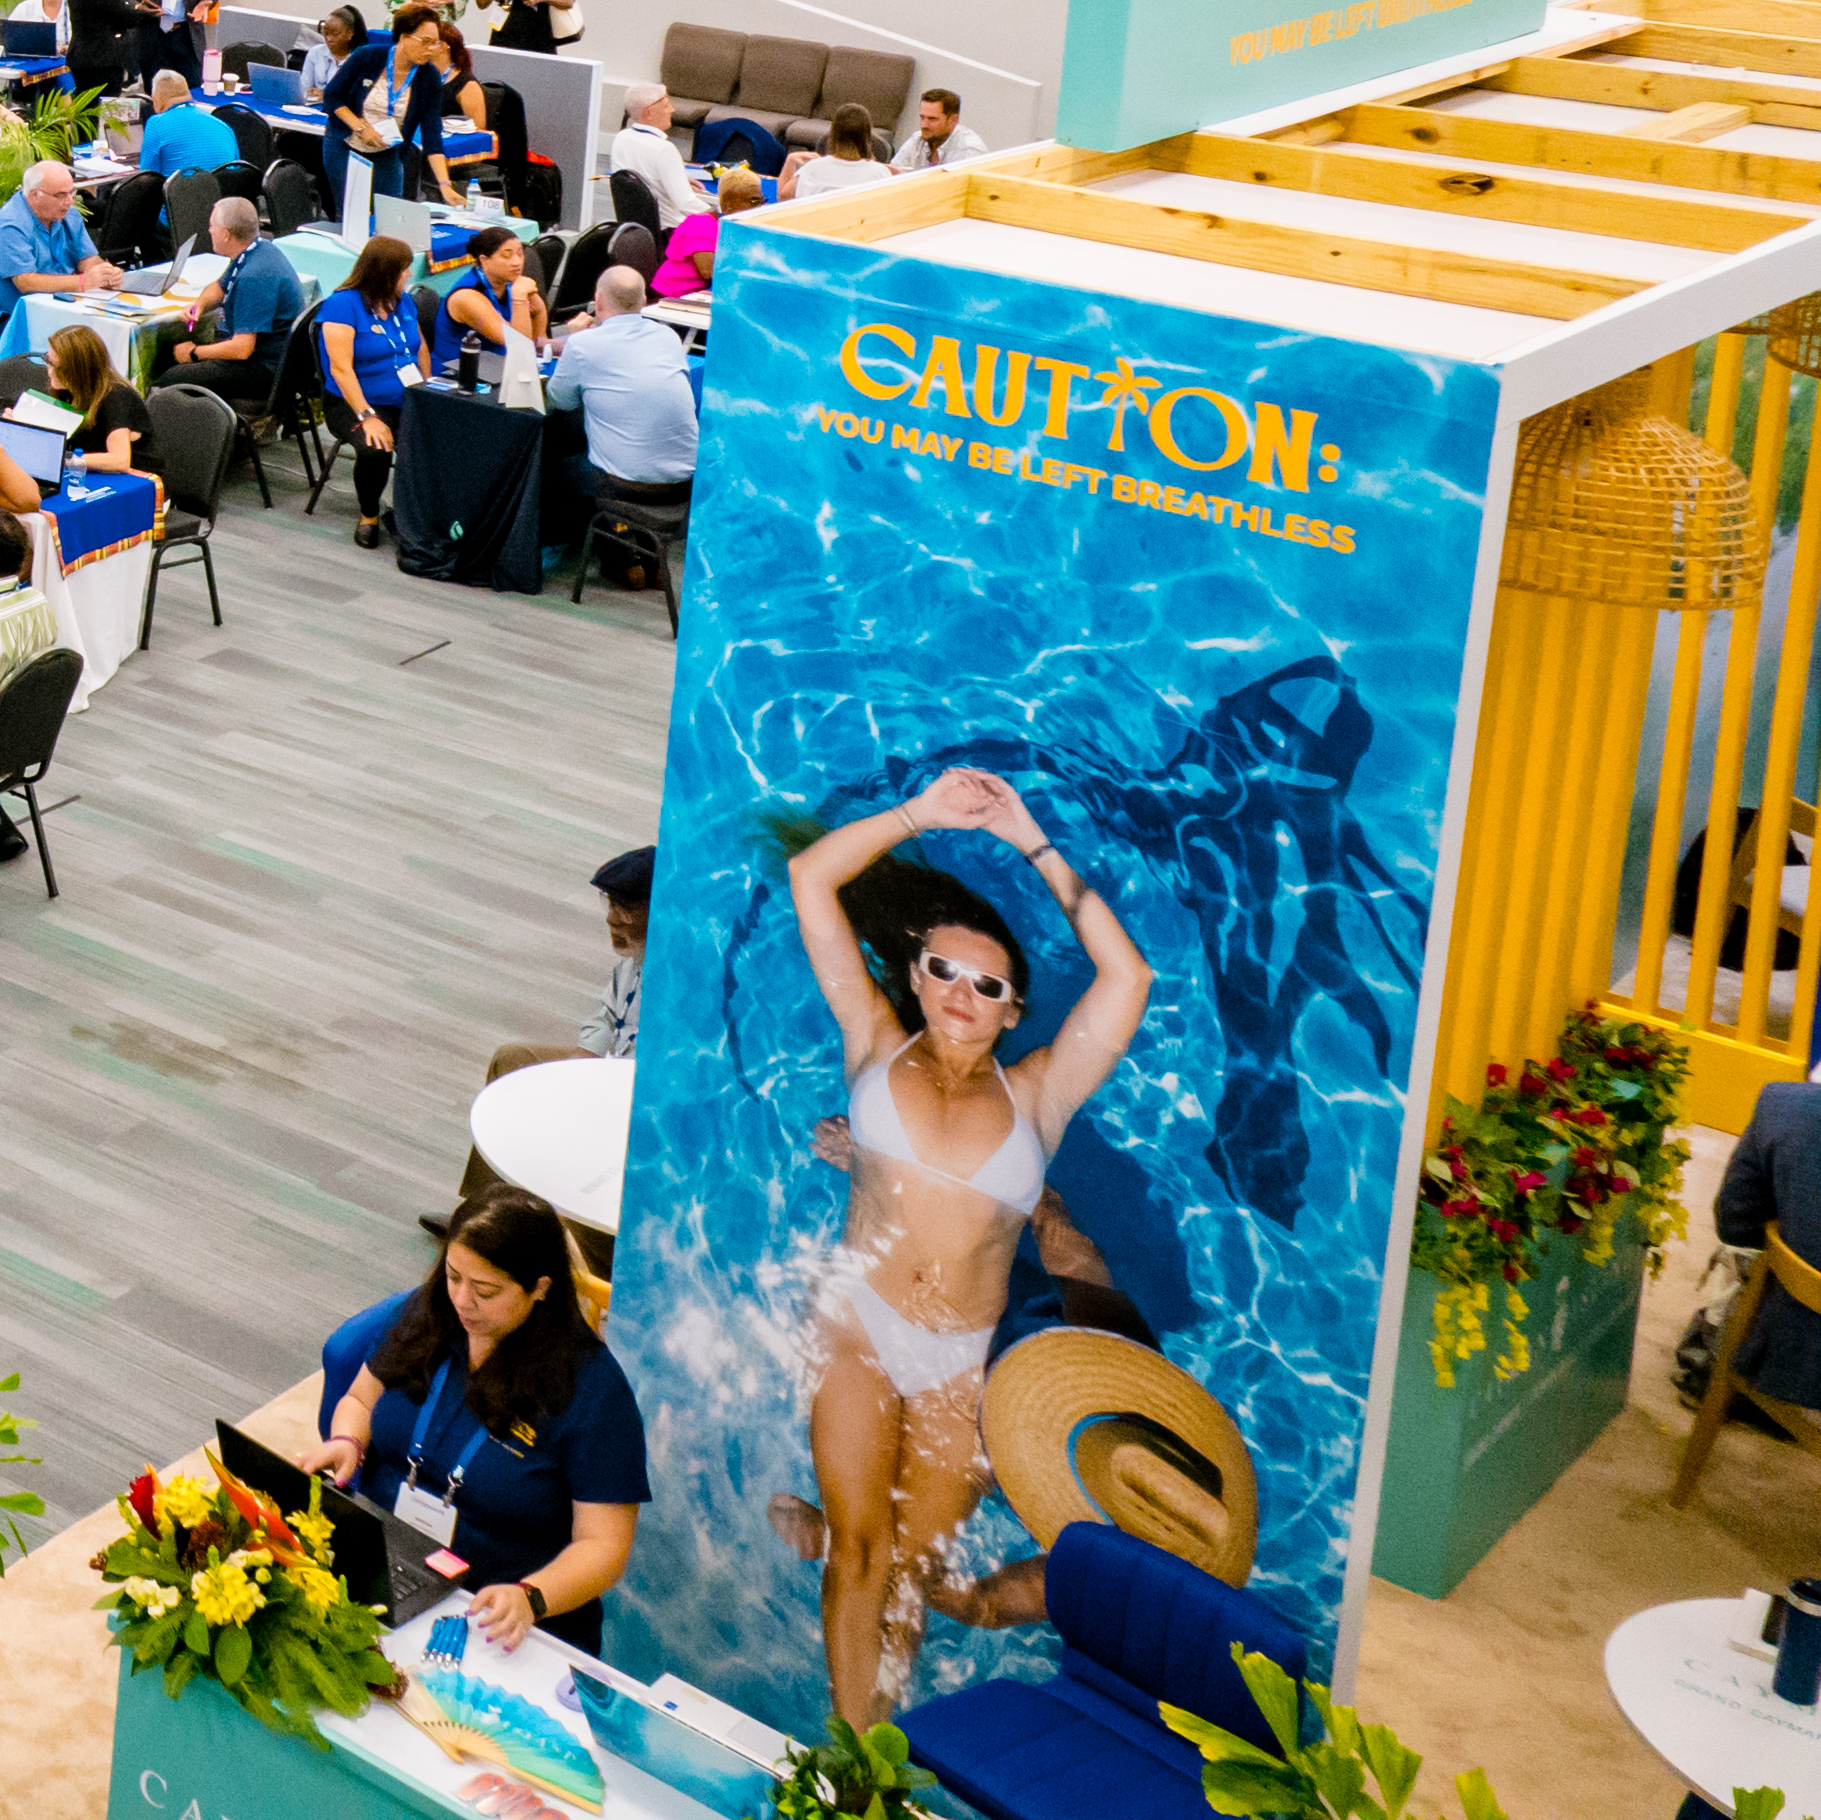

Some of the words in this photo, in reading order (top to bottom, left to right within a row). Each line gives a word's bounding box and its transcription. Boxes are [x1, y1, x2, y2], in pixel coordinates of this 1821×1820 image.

[1229, 34, 1267, 68] YOU
[1268, 21, 1309, 56] MAY
[1310, 14, 1334, 46] BE
[1334, 3, 1378, 41] LEFT
[483, 199, 502, 210] 108
[816, 405, 885, 447] YOU
[890, 423, 965, 462] MAY
[967, 440, 1013, 477] BE
[1020, 453, 1109, 497] LEFT
[1111, 473, 1357, 556] BREATHLESS
